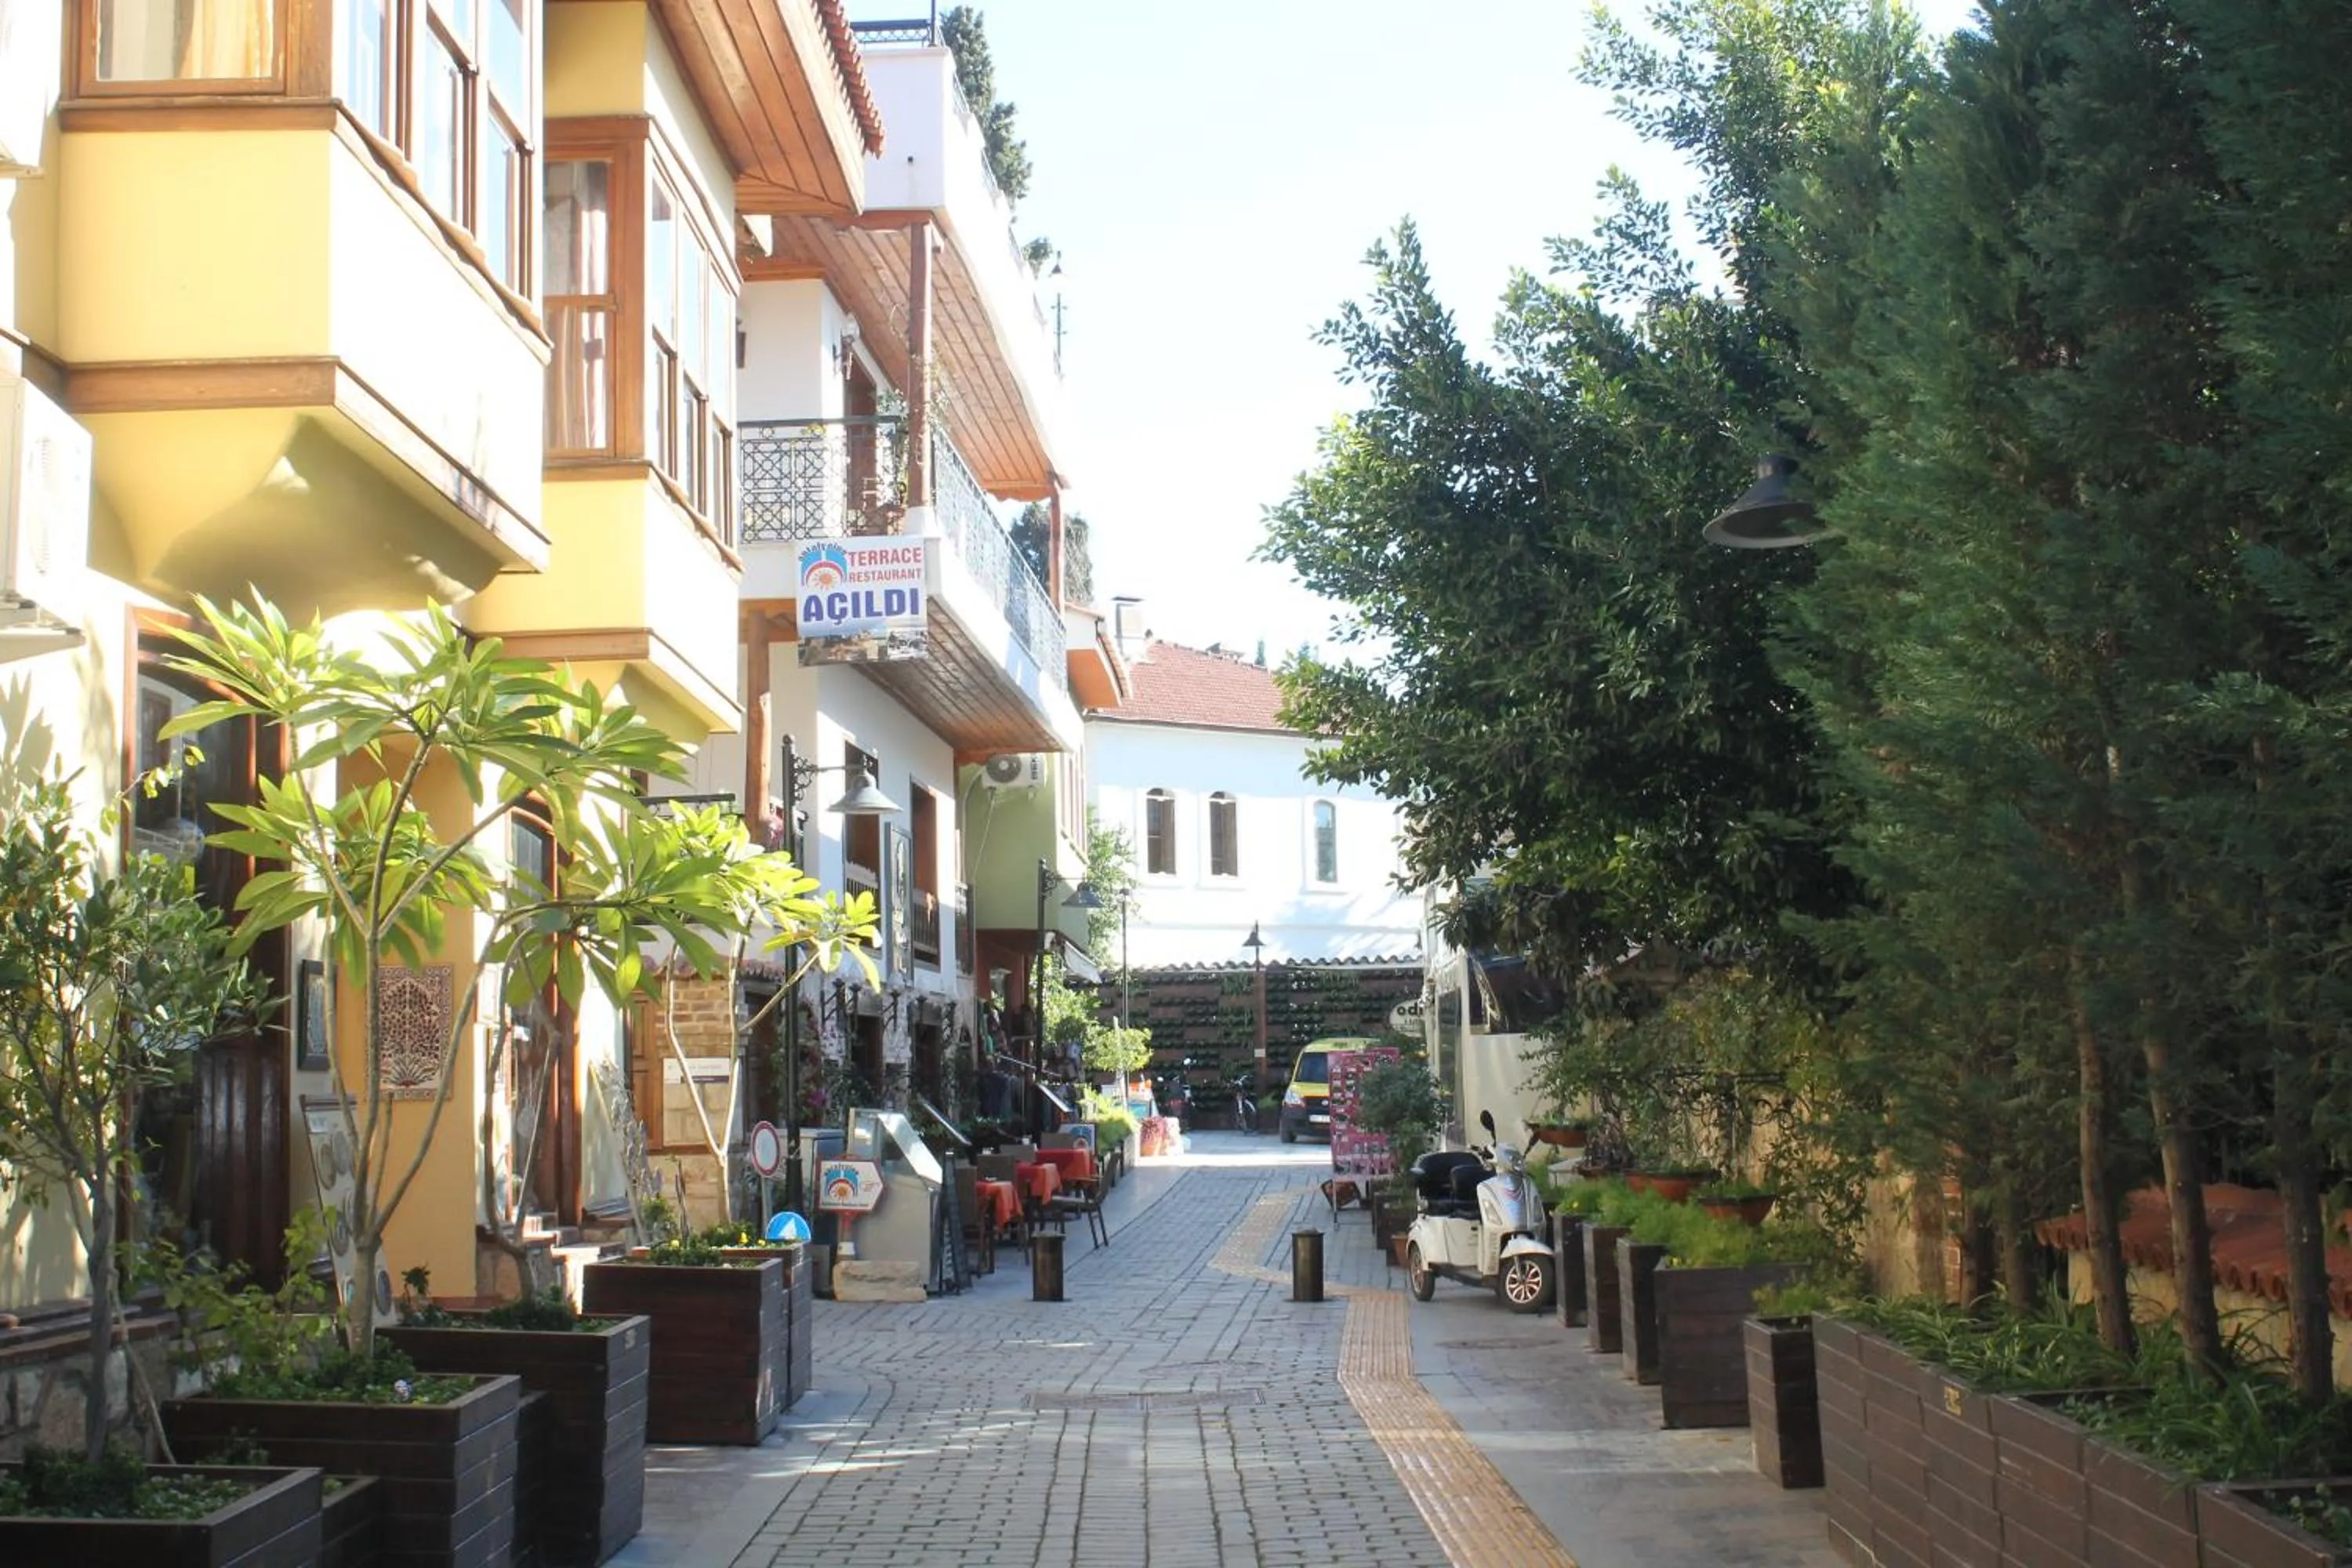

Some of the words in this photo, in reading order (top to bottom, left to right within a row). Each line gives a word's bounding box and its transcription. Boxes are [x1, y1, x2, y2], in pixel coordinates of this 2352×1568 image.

[848, 547, 921, 567] TERRACE
[849, 568, 922, 583] RESTAURANT
[803, 588, 920, 625] AÇILDI
